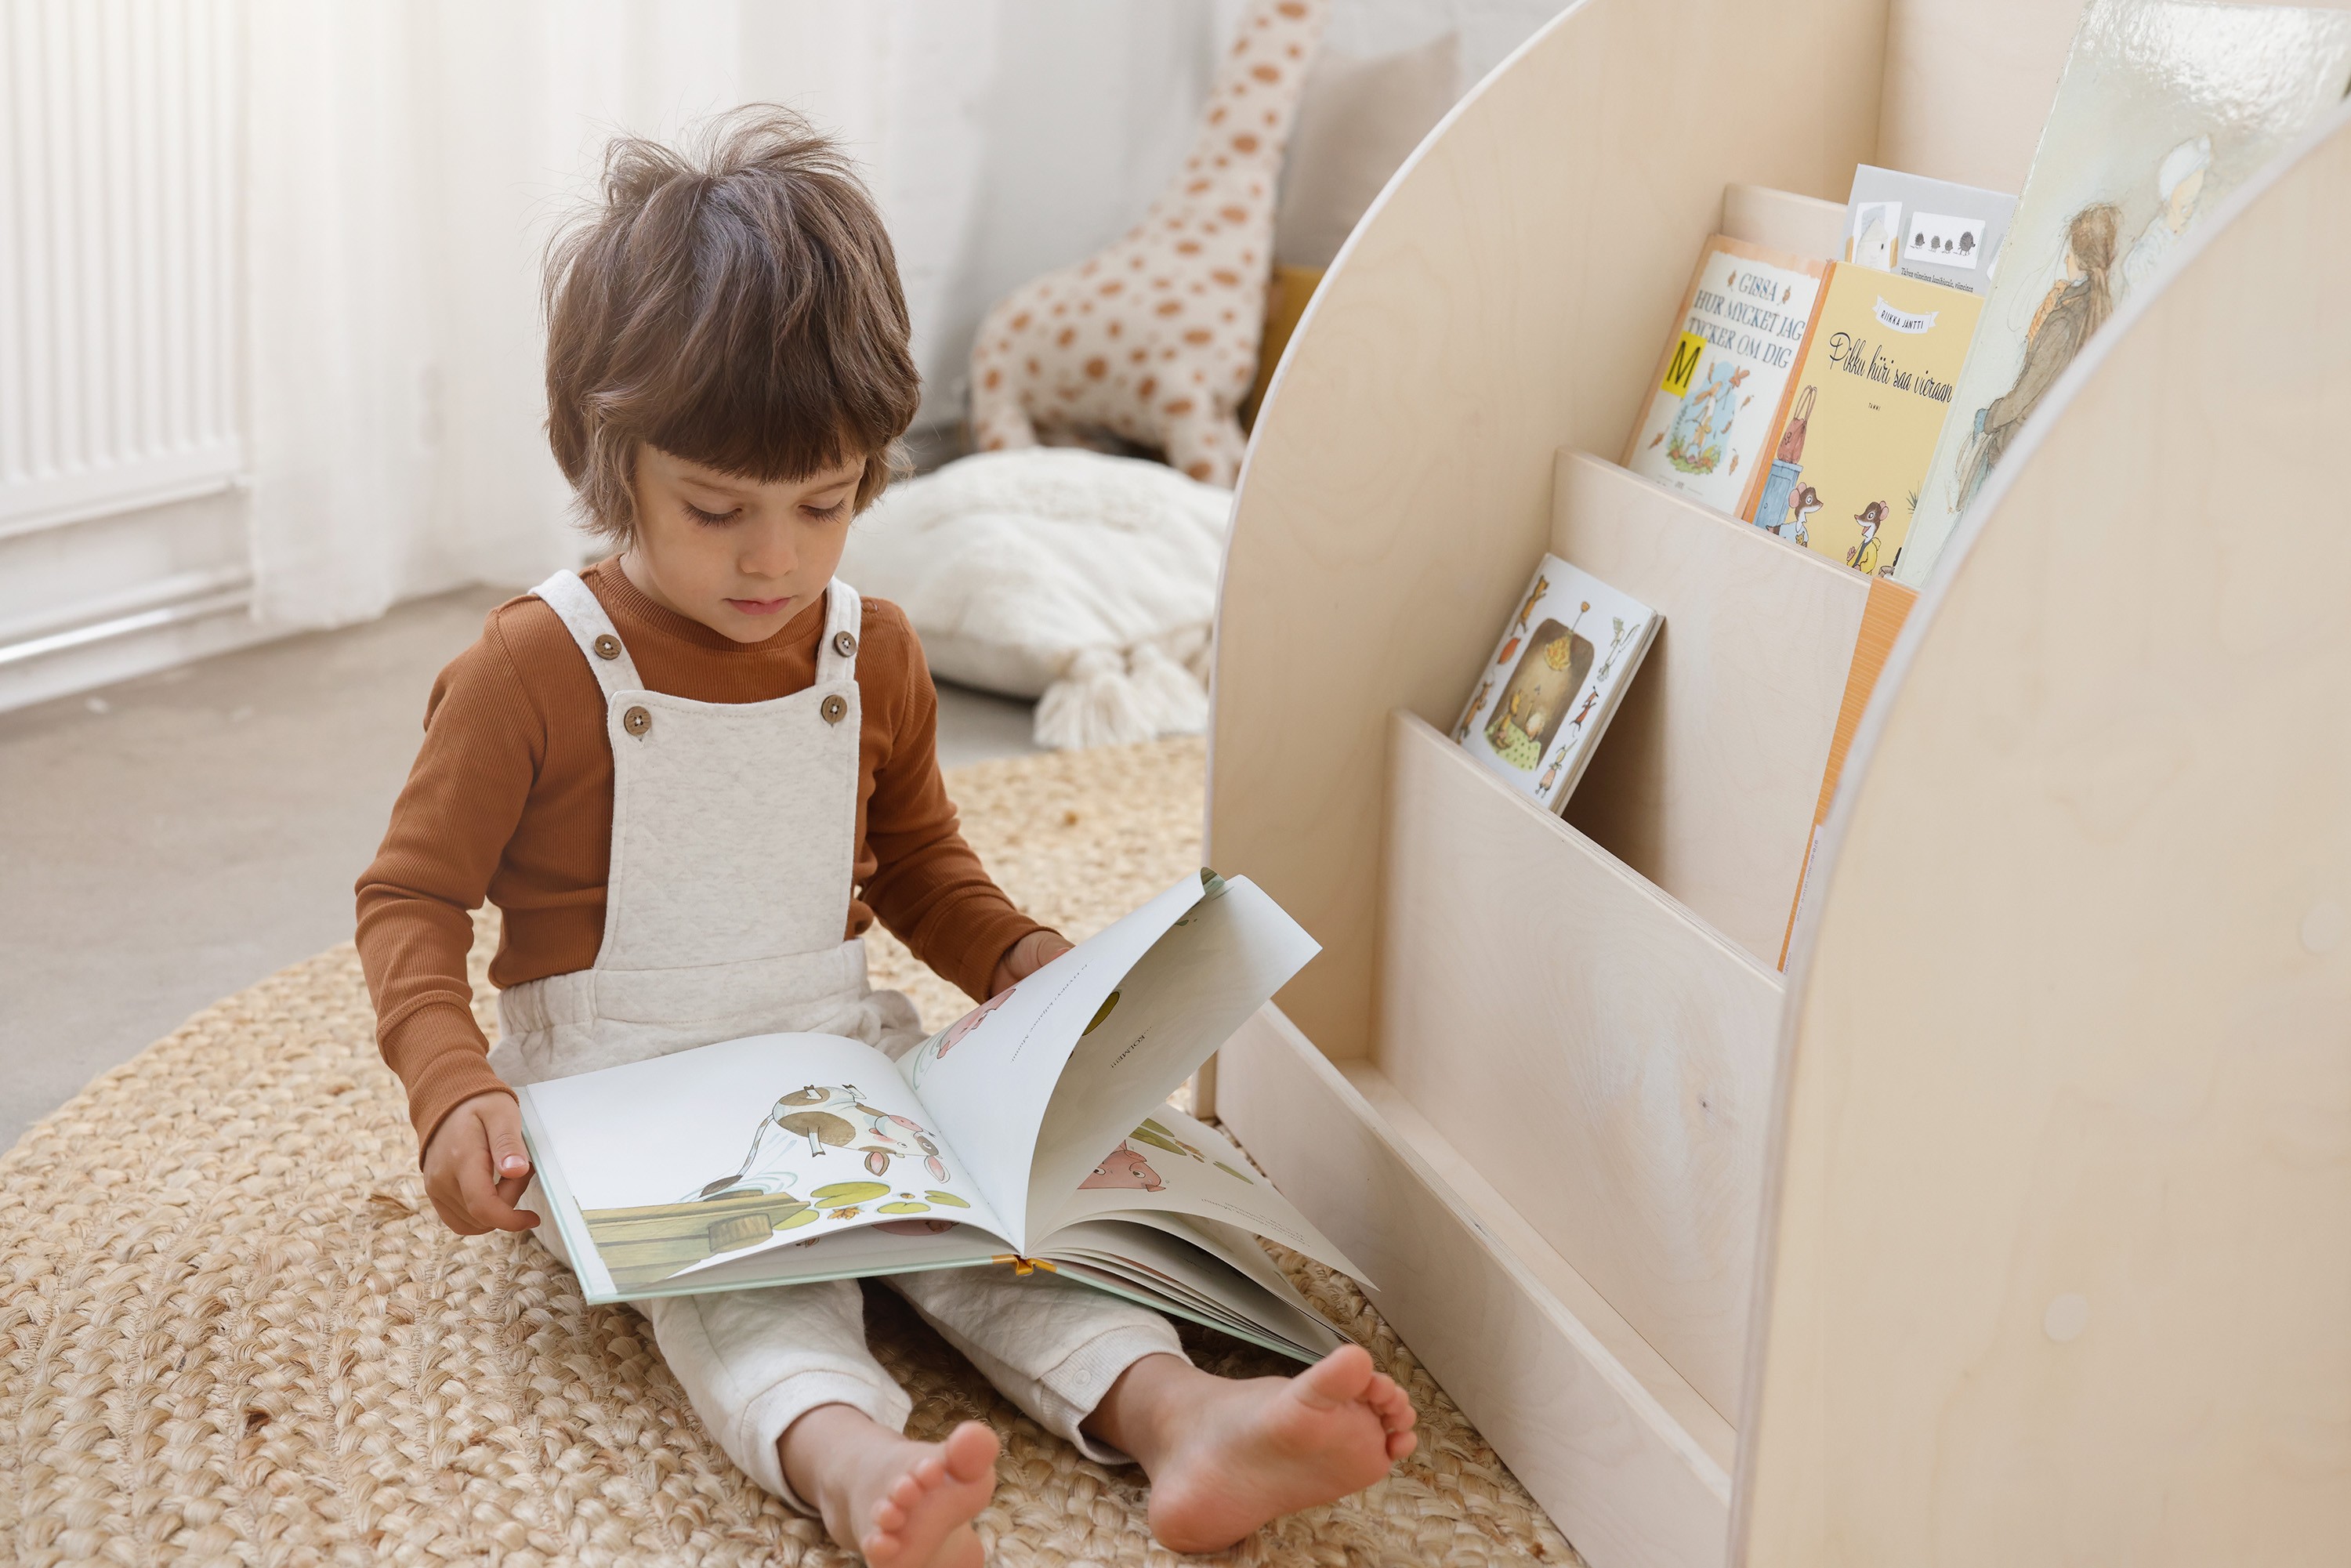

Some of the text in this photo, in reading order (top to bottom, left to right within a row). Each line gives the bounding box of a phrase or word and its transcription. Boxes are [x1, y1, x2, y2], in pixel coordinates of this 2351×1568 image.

[1739, 273, 1778, 302] GISSA
[1694, 289, 1806, 342] HUR MYCKET JAG
[1881, 310, 1900, 326] RIIKKA
[1666, 340, 1701, 389] M
[1689, 316, 1792, 369] TYCKER OM DIG
[1829, 331, 1953, 404] Pikku hiiri saa vieraan
[1868, 402, 1881, 411] TAMMI
